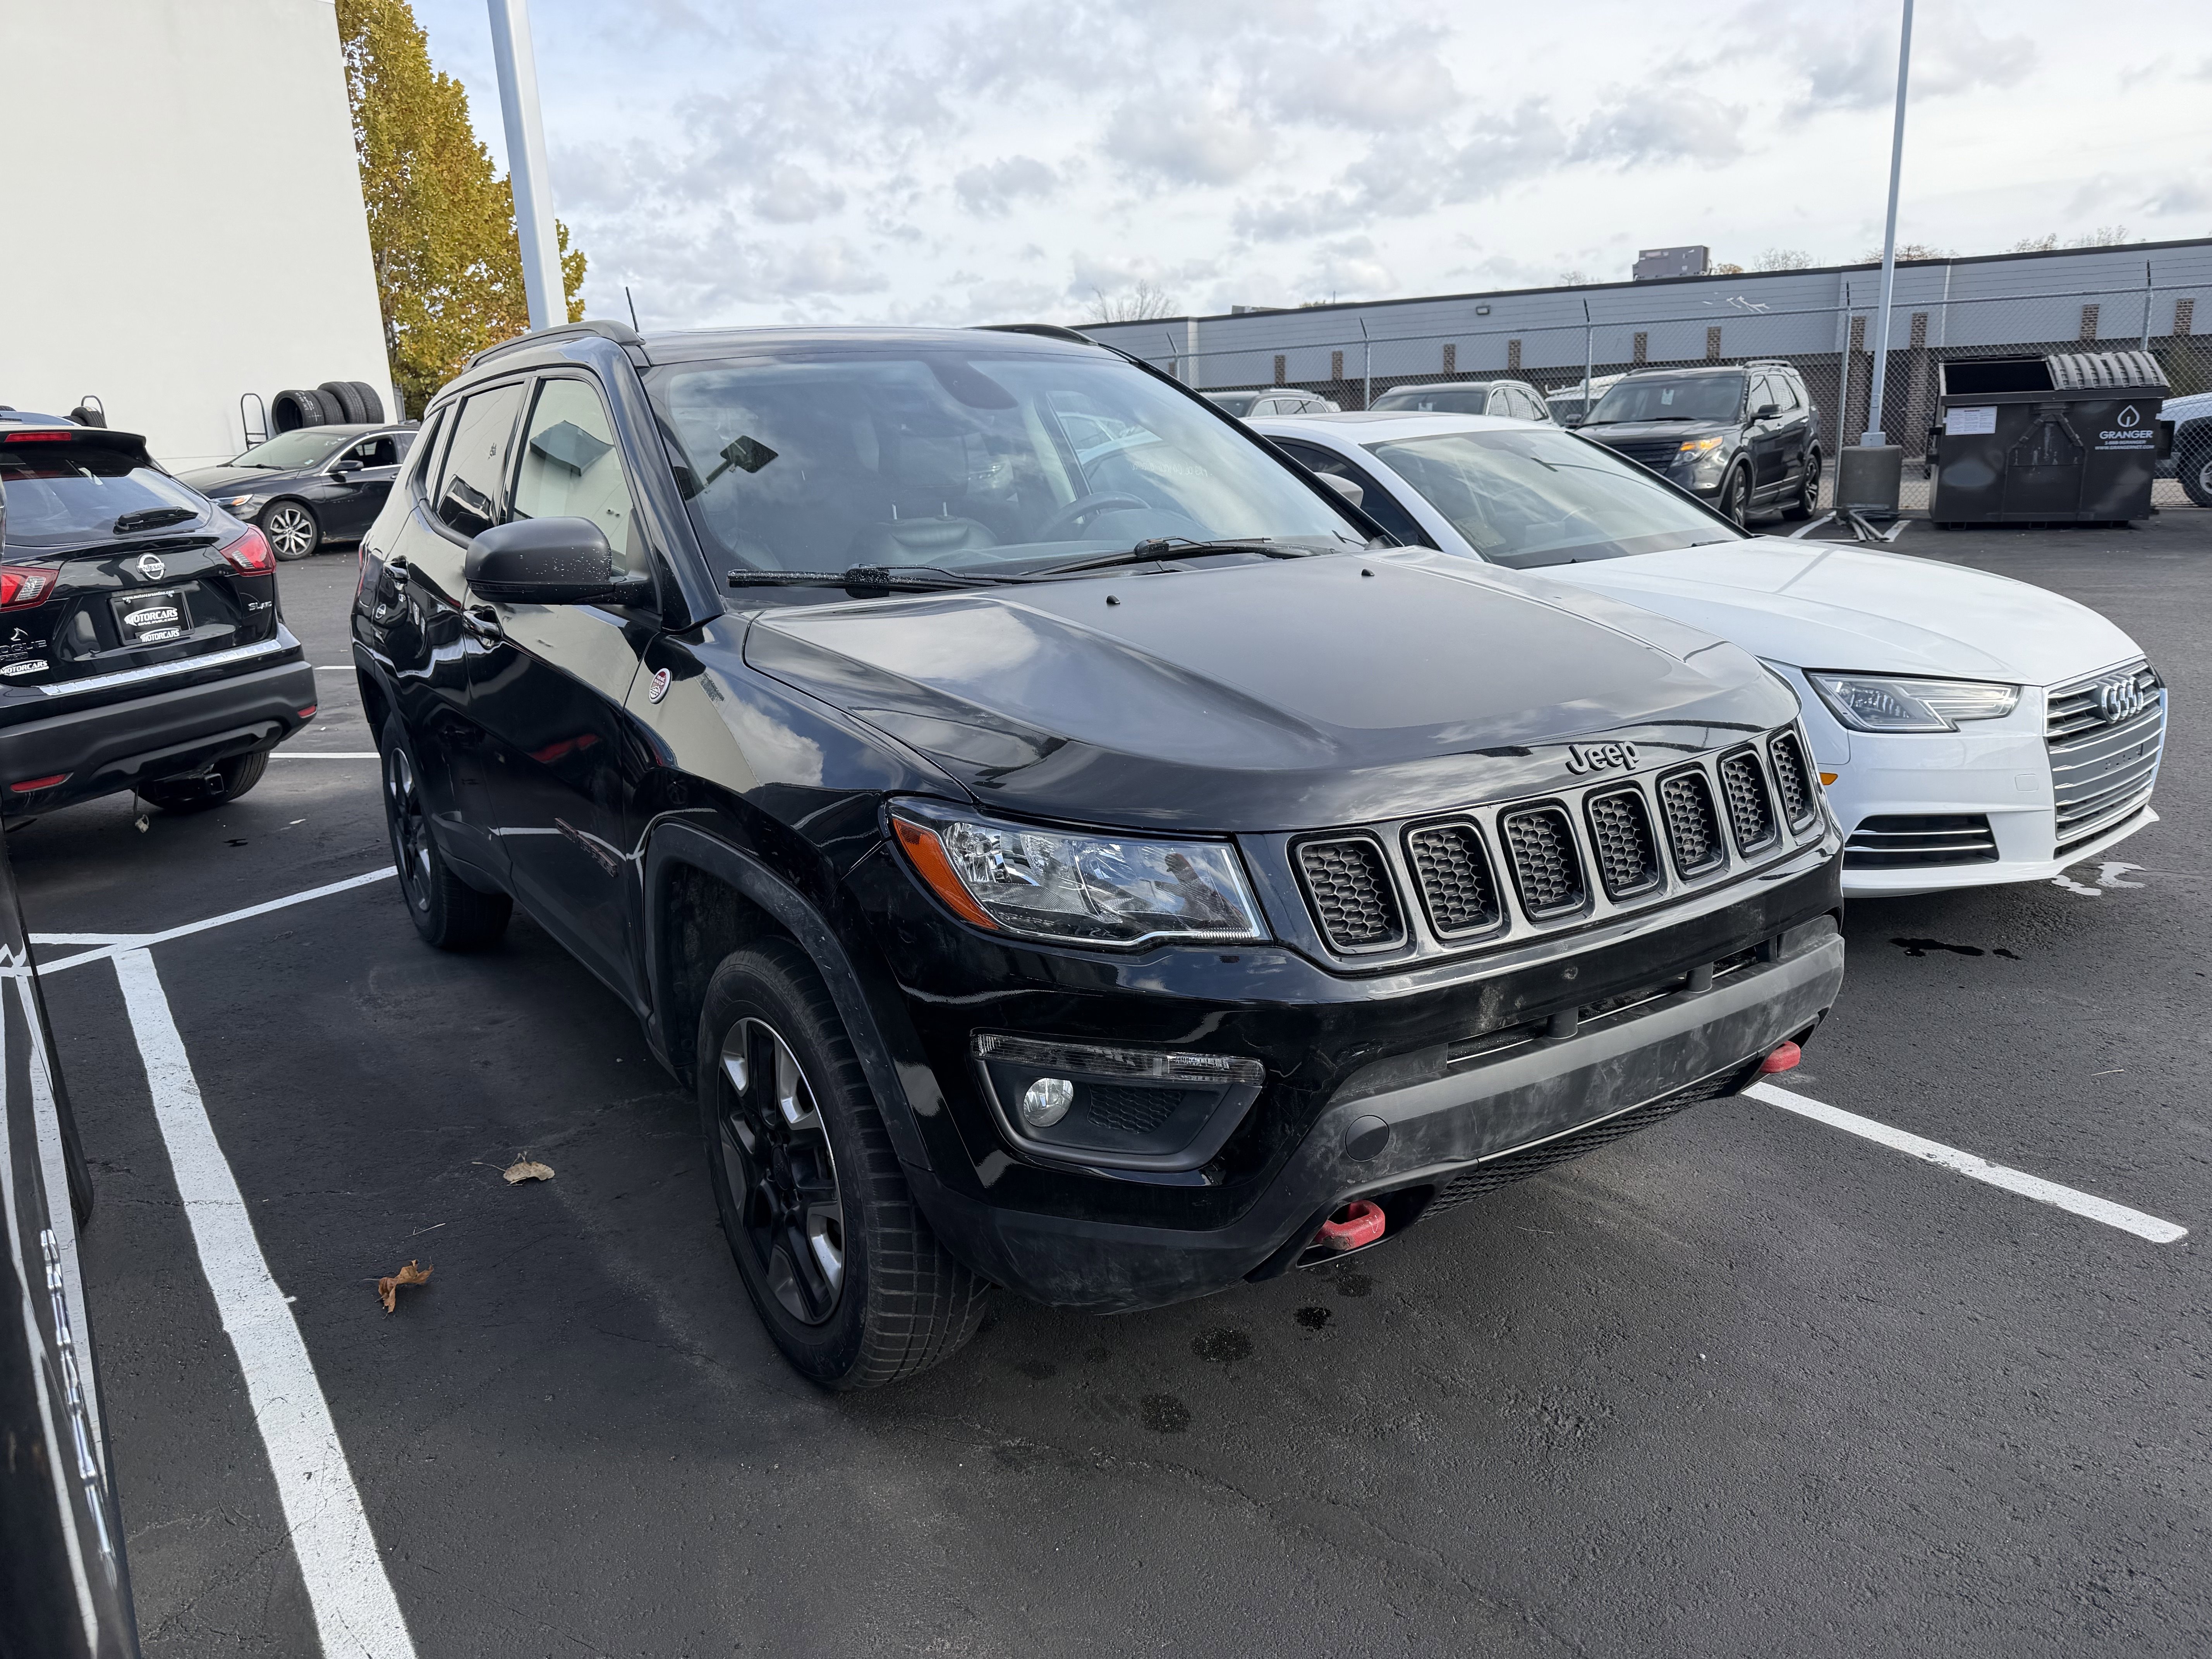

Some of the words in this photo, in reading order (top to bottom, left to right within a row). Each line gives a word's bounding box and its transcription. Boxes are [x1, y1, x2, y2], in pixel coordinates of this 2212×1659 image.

[2099, 430, 2154, 439] GRANGER
[125, 609, 178, 624] MOTORCARS
[141, 630, 180, 642] MOTORCARS
[0, 640, 47, 653] OGUE
[0, 661, 48, 674] MOTORCARS
[1565, 741, 1640, 775] Jeep
